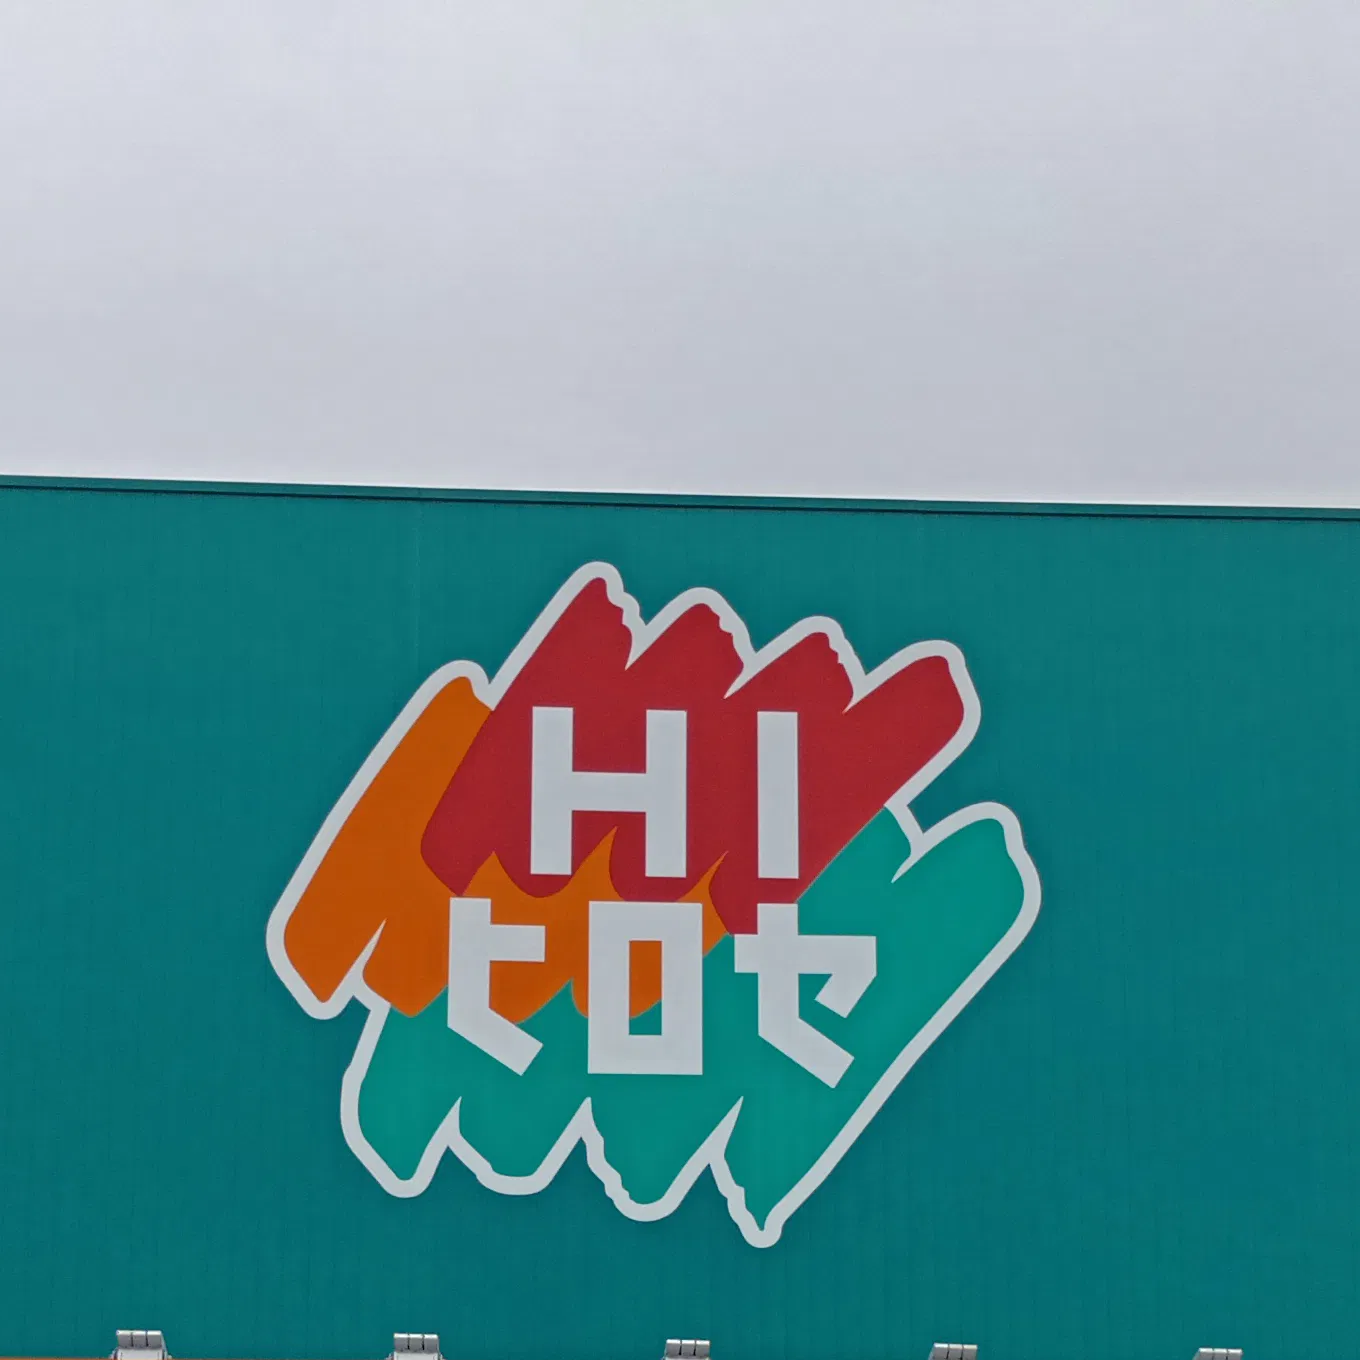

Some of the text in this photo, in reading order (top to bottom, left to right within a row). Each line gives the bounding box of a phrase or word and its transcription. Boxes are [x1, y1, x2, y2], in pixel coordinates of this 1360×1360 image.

[531, 706, 799, 879] HI
[447, 897, 877, 1089] ヒロセ
